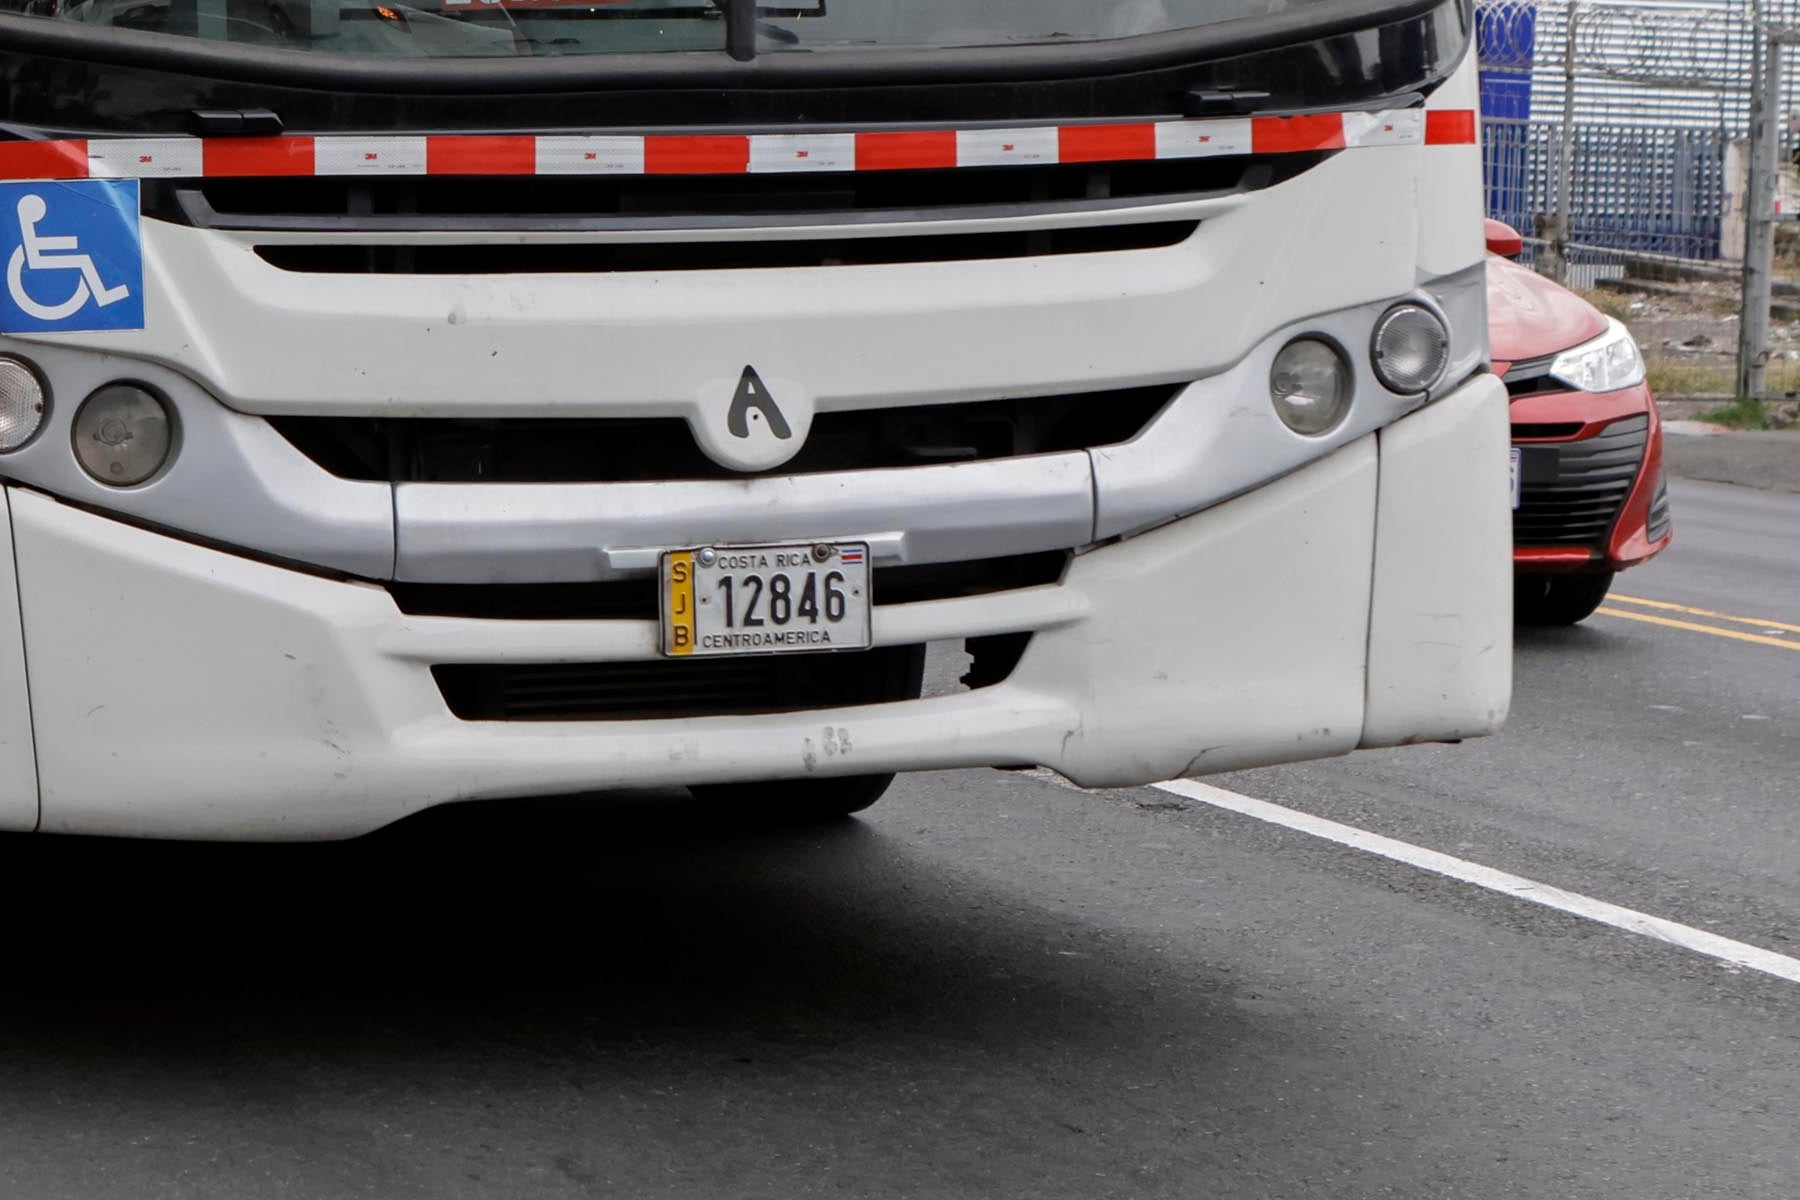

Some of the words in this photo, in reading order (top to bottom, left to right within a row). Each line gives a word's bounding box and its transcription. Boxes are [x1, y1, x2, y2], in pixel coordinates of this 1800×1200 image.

[718, 553, 769, 570] COSTA
[776, 552, 812, 568] RICA
[718, 571, 845, 628] 12846
[702, 630, 831, 649] CENTROAMERICA
